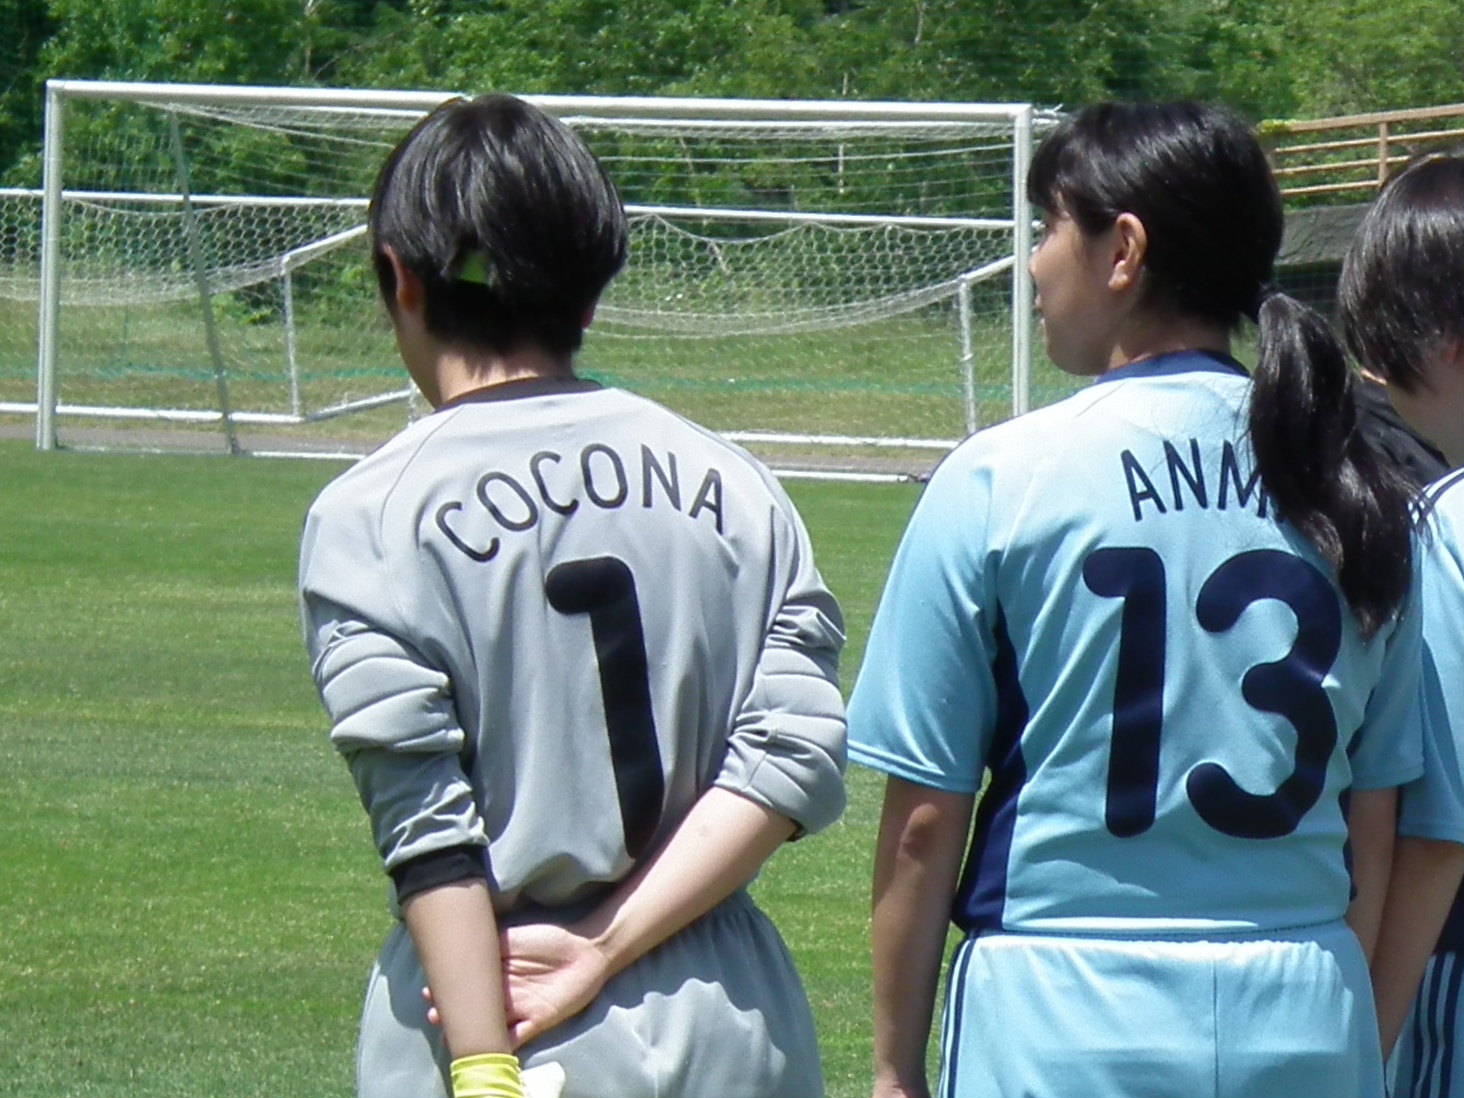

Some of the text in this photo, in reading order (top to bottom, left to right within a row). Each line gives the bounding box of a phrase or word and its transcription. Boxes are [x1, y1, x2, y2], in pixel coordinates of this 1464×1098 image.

[435, 443, 725, 562] COCONA
[546, 555, 665, 860] 1
[1082, 546, 1342, 840] 13
